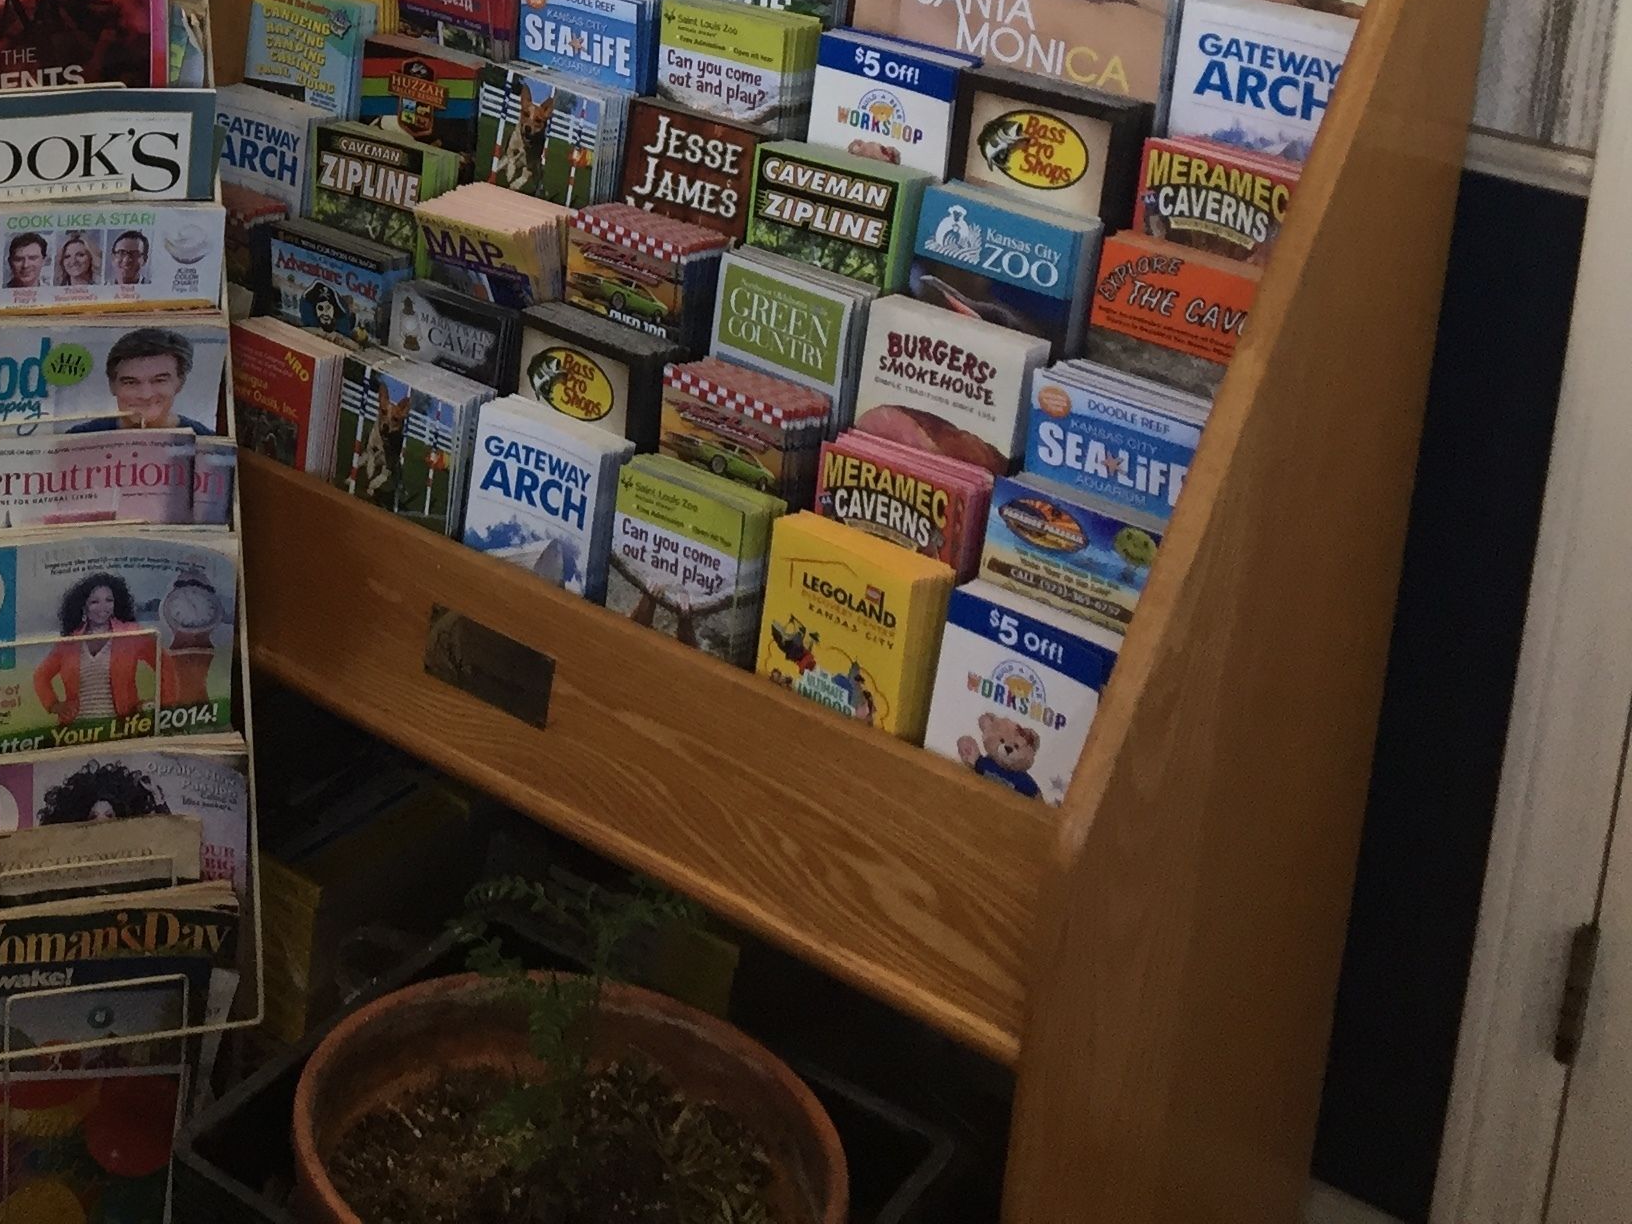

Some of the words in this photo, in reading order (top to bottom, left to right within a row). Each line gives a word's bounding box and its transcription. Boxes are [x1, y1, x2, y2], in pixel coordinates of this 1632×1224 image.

[524, 14, 575, 58] SEA
[546, 9, 581, 27] KANSAS
[0, 47, 38, 66] THE
[667, 49, 693, 71] Can
[697, 57, 723, 78] you
[725, 63, 762, 87] come
[854, 46, 880, 78] $5
[884, 59, 920, 85] Off!
[955, 8, 1130, 94] MONICA
[1198, 32, 1344, 86] GATEWAY
[391, 76, 445, 98] HUZZAH
[669, 71, 692, 90] out
[696, 74, 722, 96] and
[725, 80, 768, 111] play?
[1193, 60, 1335, 121] ARCH
[644, 115, 743, 176] JESSE
[836, 105, 924, 145] WORKSHOP
[1019, 135, 1055, 160] Pro
[1024, 114, 1068, 146] Bass
[220, 135, 299, 186] ARCH
[339, 138, 401, 164] CAVEMAN
[1019, 153, 1074, 186] Shops
[319, 151, 419, 210] ZIPLINE
[762, 158, 891, 212] CAVEMAN
[1145, 148, 1291, 224] MERAMEC
[6, 213, 53, 230] COOK
[56, 212, 94, 228] LIKE
[95, 213, 107, 226] A
[763, 192, 887, 247] ZIPLINE
[1158, 185, 1269, 244] CAVERNS
[982, 244, 1060, 289] ZOO
[985, 228, 1030, 254] Kansas
[1034, 242, 1061, 264] City
[1098, 255, 1185, 302] EXPLORE
[1128, 279, 1180, 317] THE
[729, 285, 832, 349] GREEN
[562, 351, 596, 381] Bass
[727, 318, 824, 372] COUNTRY
[887, 331, 998, 385] BURGERS'
[561, 387, 603, 417] Shops
[562, 372, 587, 395] Pro
[879, 355, 994, 407] SMOKEHOUSE
[1037, 421, 1108, 479] SEA
[1070, 419, 1124, 444] KANSAS
[484, 434, 593, 493] GATEWAY
[480, 459, 588, 531] ARCH
[822, 451, 949, 528] MERAMEC
[834, 488, 931, 548] CAVERNS
[621, 517, 648, 542] Can
[653, 529, 679, 554] you
[682, 545, 721, 573] come
[622, 542, 647, 563] out
[650, 551, 679, 574] and
[682, 563, 724, 596] play?
[1010, 566, 1036, 584] CALL
[802, 571, 897, 629] LEGOLAND
[808, 603, 859, 633] KANSAS
[864, 629, 895, 651] CITY
[989, 606, 1019, 646] $5
[1023, 629, 1065, 664] Off!
[966, 670, 1067, 731] WORKSHOP
[51, 723, 104, 749] Your
[108, 715, 152, 741] Life
[159, 702, 220, 729] 2014!
